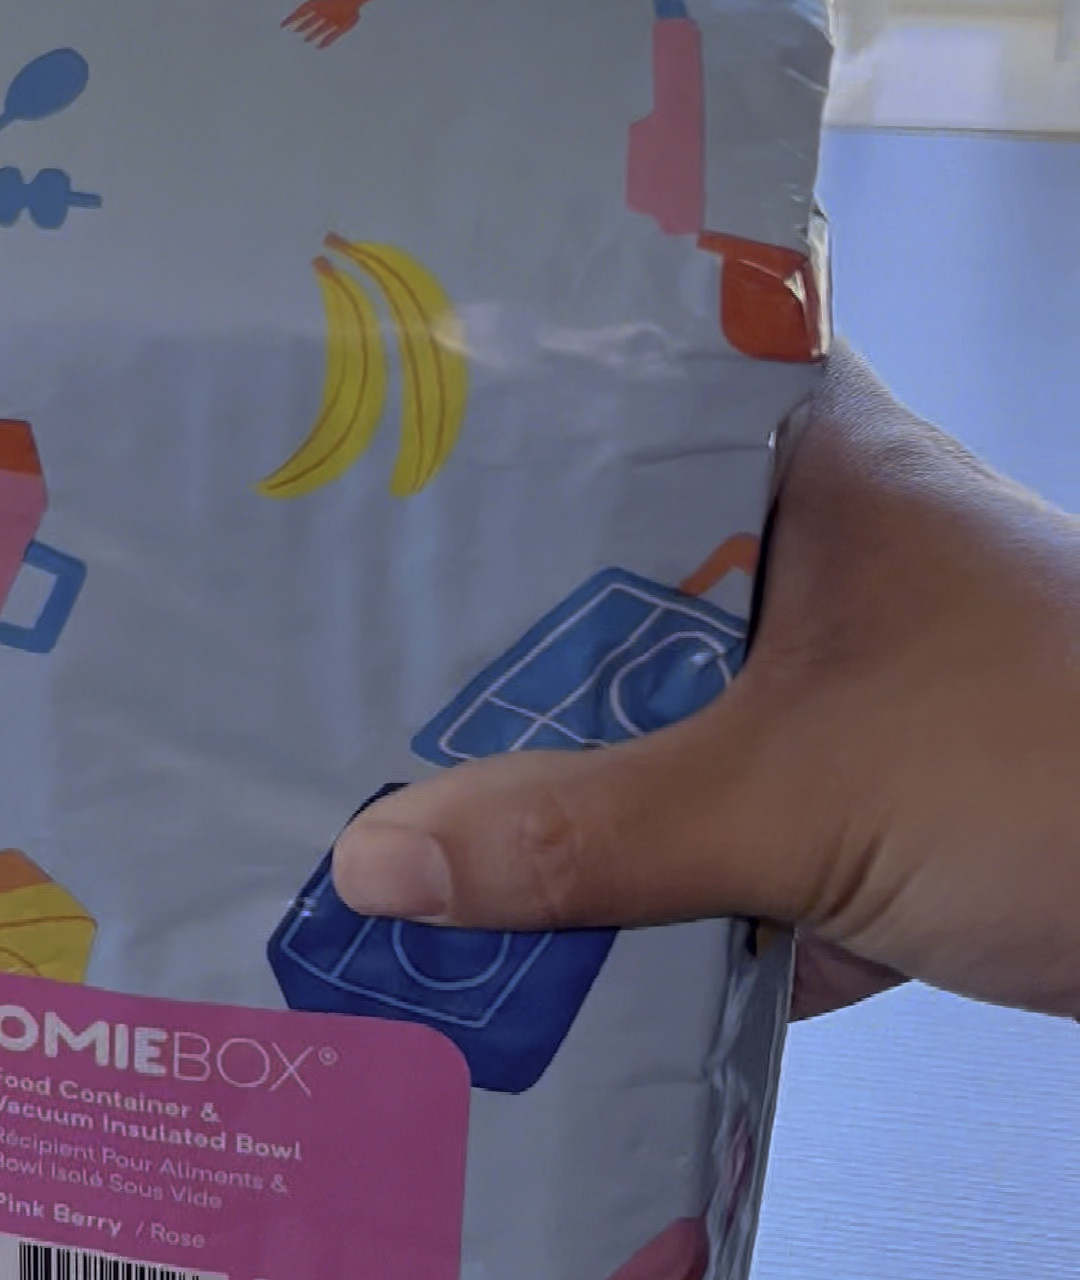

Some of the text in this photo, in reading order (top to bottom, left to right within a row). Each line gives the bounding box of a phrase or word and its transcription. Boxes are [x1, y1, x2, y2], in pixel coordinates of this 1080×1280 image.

[58, 1080, 191, 1119] Container
[200, 1102, 220, 1122] &
[103, 1113, 227, 1151] Insulated
[236, 1132, 302, 1160] Bowl
[51, 1161, 103, 1188] Isolé
[109, 1172, 163, 1201] Sous
[170, 1183, 222, 1208] Vide
[102, 1147, 152, 1172] Pour
[159, 1158, 264, 1190] Aliments
[271, 1173, 287, 1193] &
[54, 1202, 121, 1237] Berry
[150, 1222, 206, 1249] Rose
